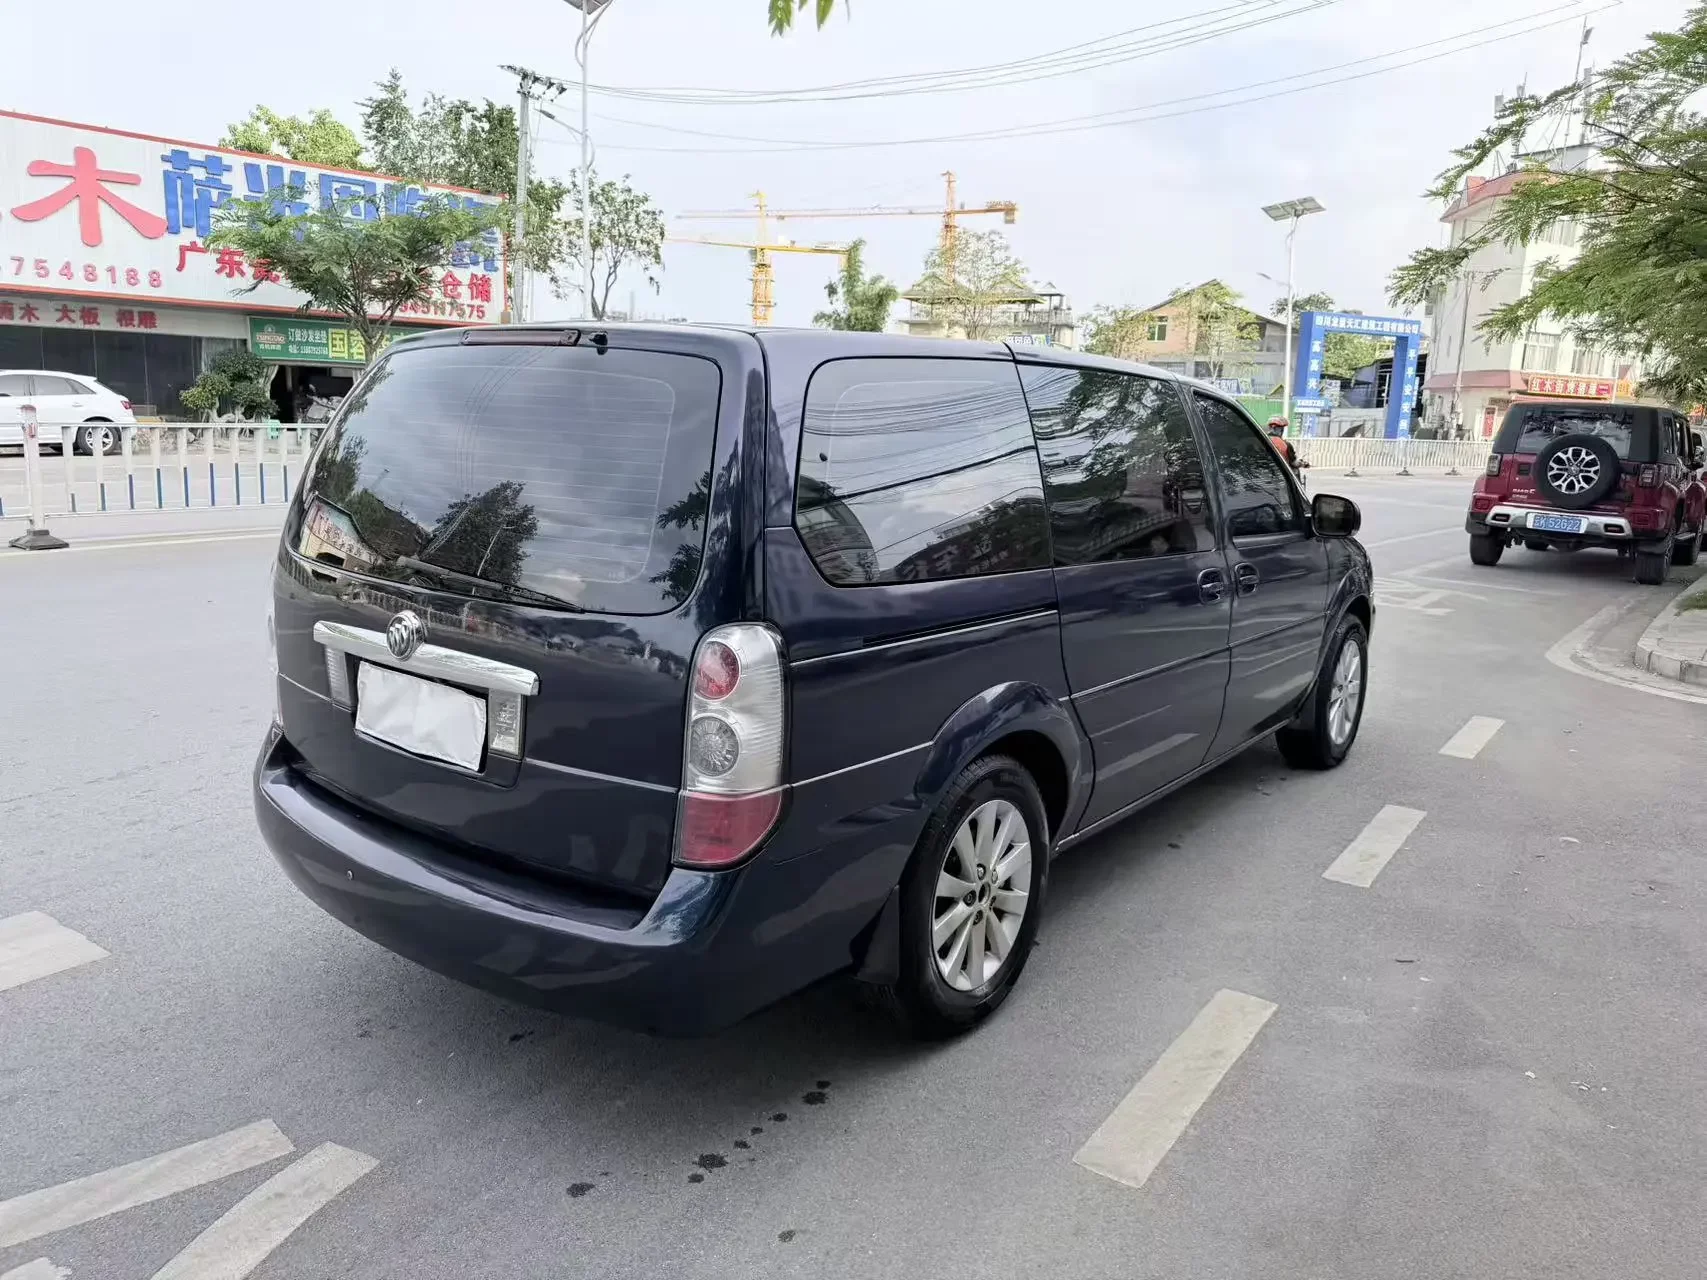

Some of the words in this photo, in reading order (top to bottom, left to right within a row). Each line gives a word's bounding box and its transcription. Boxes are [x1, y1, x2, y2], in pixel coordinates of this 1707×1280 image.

[10, 146, 168, 247] 木
[55, 303, 101, 326] 大板
[116, 308, 158, 329] 根雕
